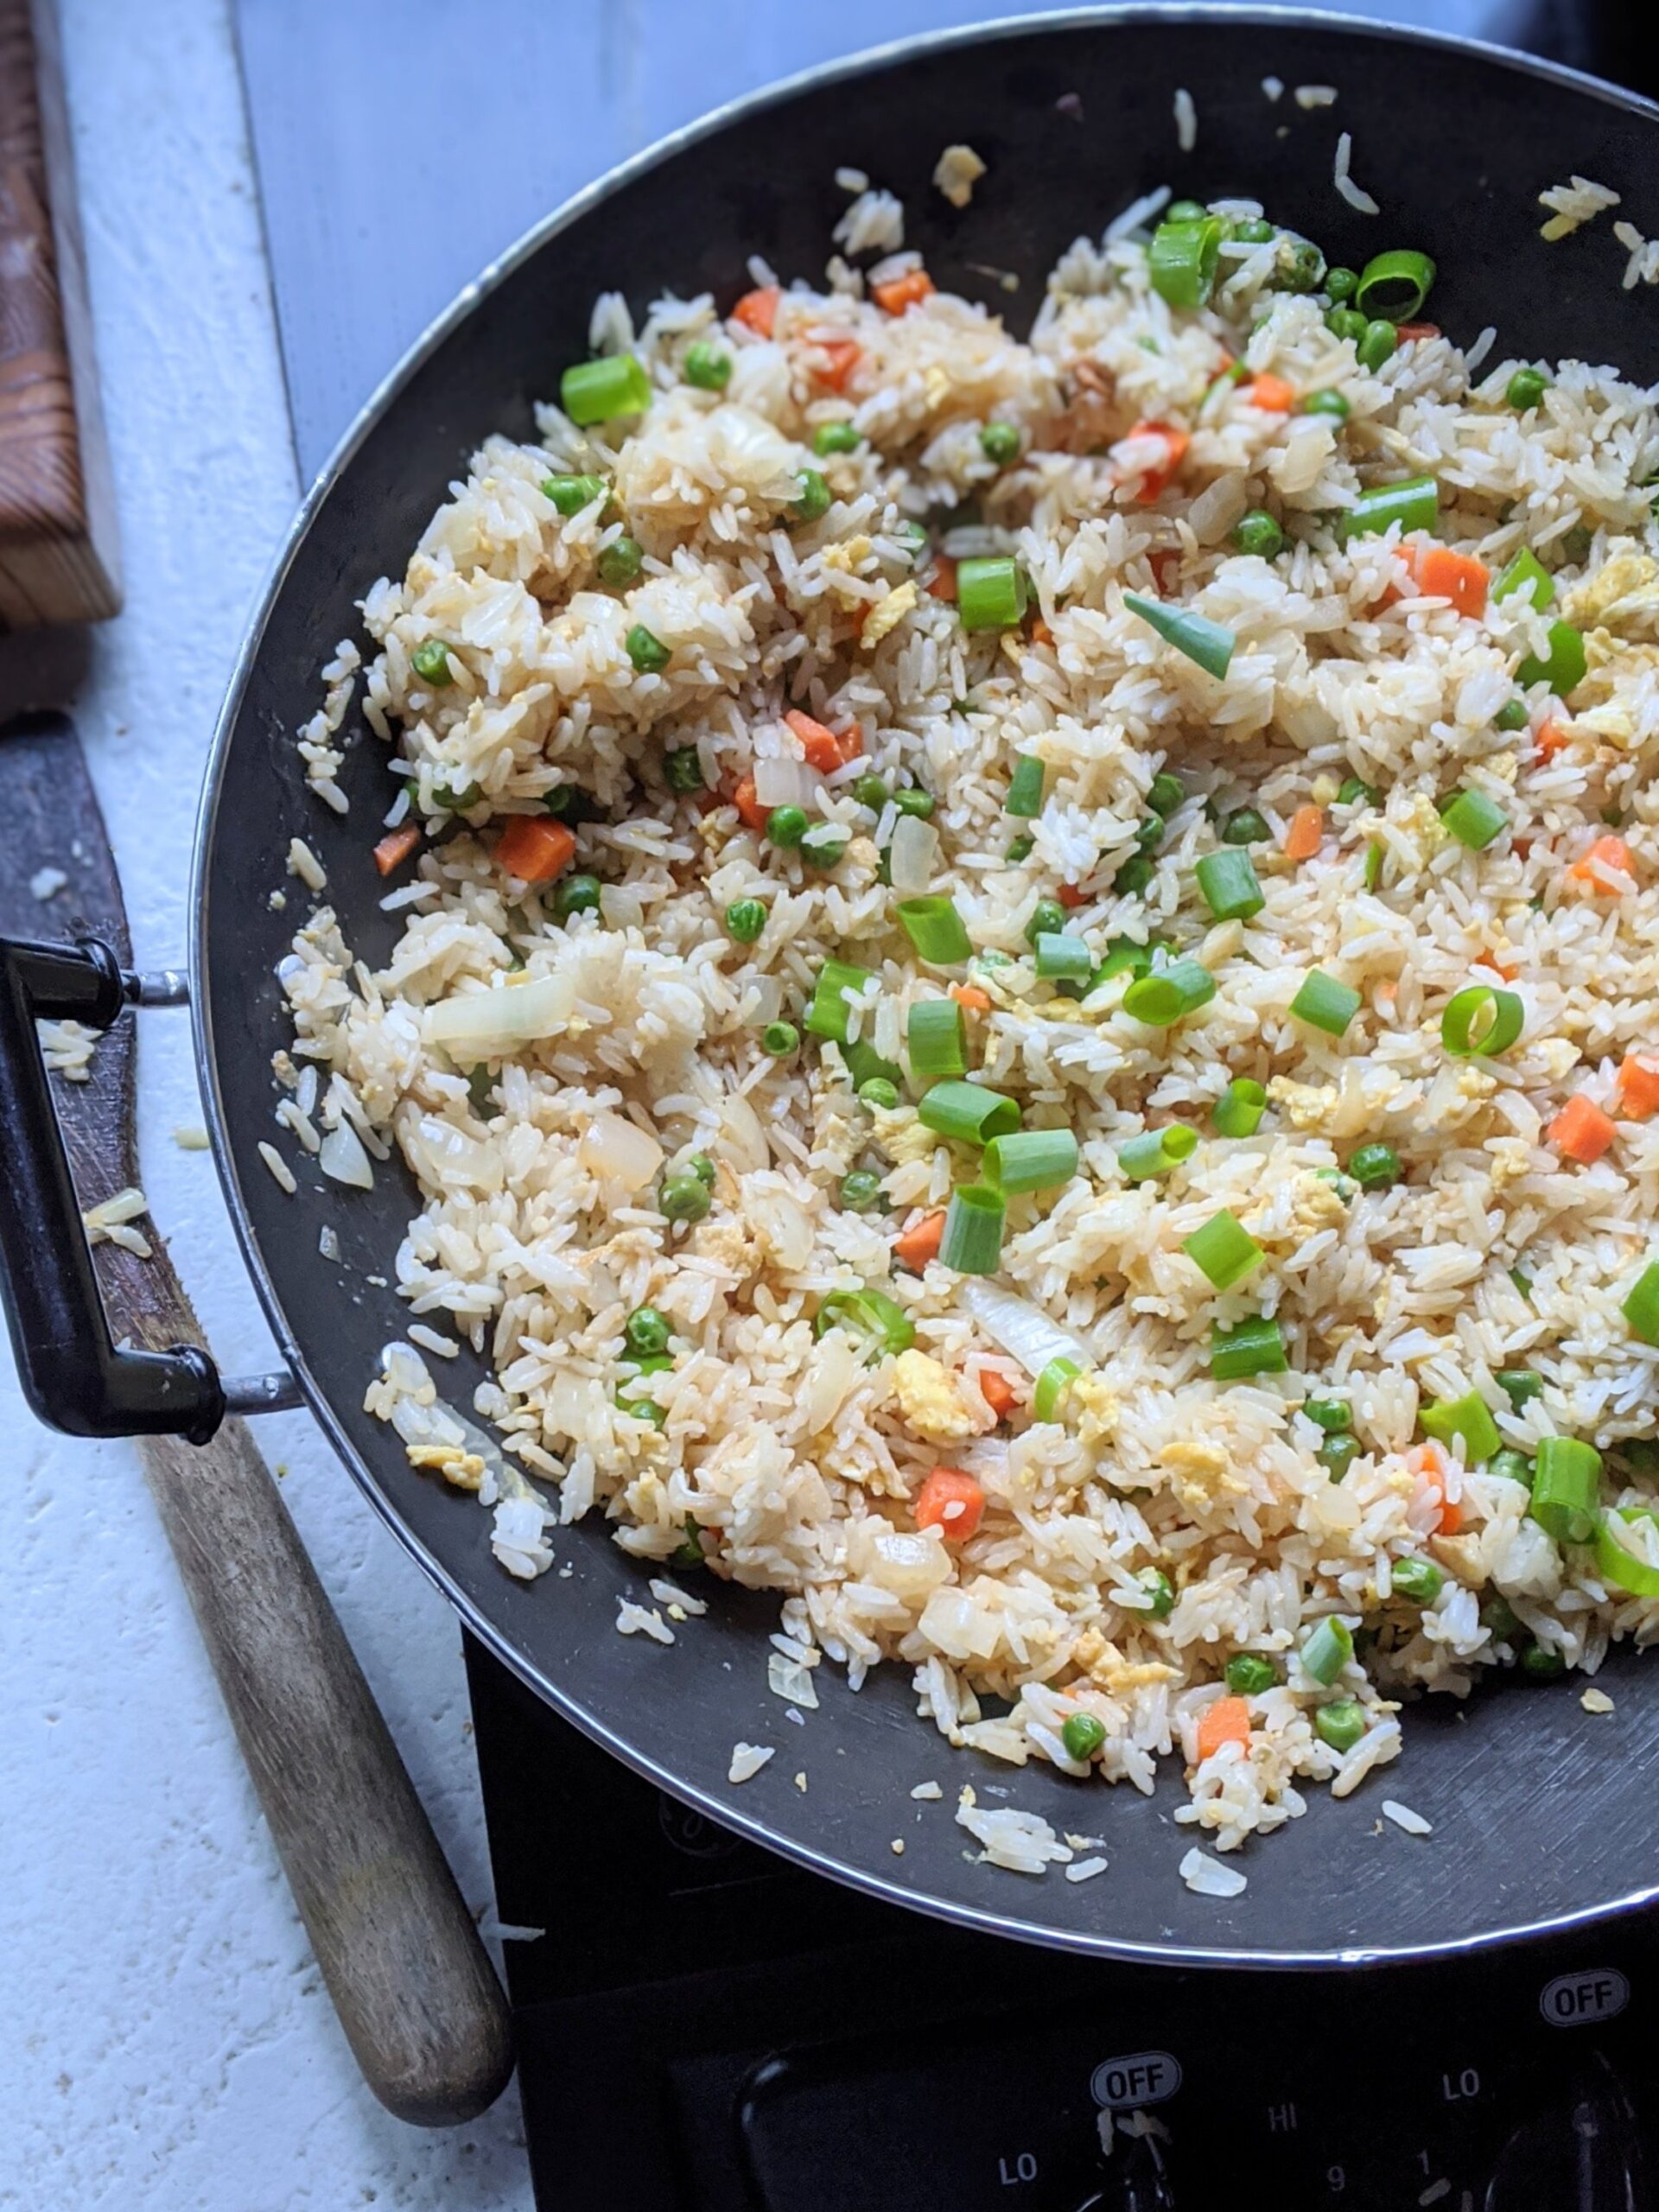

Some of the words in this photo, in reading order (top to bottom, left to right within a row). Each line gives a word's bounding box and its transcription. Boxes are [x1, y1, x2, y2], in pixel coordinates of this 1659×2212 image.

[1555, 1980, 1612, 2017] OFF
[1106, 2063, 1163, 2100] OFF
[1442, 2068, 1480, 2101] LO
[1268, 2101, 1297, 2133] HI
[998, 2152, 1038, 2185] LO
[1327, 2164, 1346, 2192] 9
